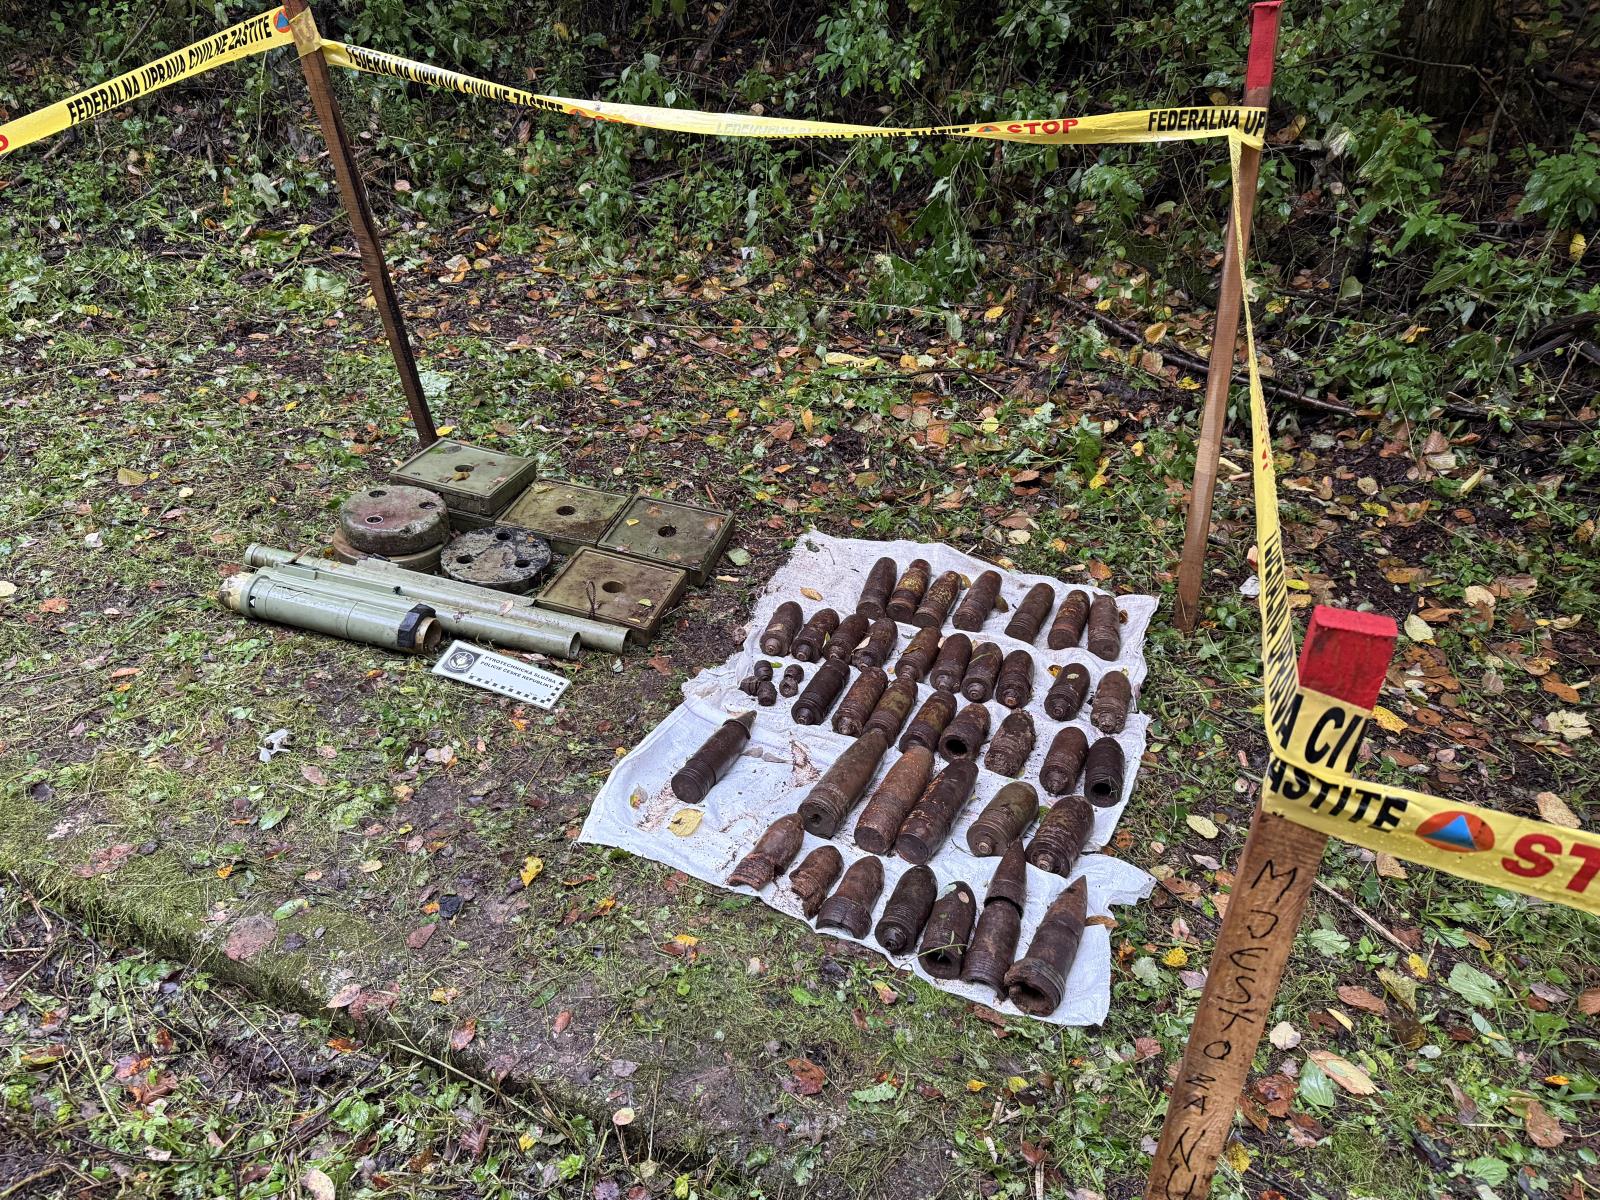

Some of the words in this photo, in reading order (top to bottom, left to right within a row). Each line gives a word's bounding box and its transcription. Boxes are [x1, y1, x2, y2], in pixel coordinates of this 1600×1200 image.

[66, 75, 140, 125] FEDERALNA
[141, 54, 185, 91] UPRAVA
[188, 34, 228, 70] CIVILNE
[1007, 118, 1078, 134] STOP
[1148, 109, 1239, 132] FEDERALNA
[480, 661, 502, 671] POLICIE
[522, 675, 554, 689] REPUBLIKY
